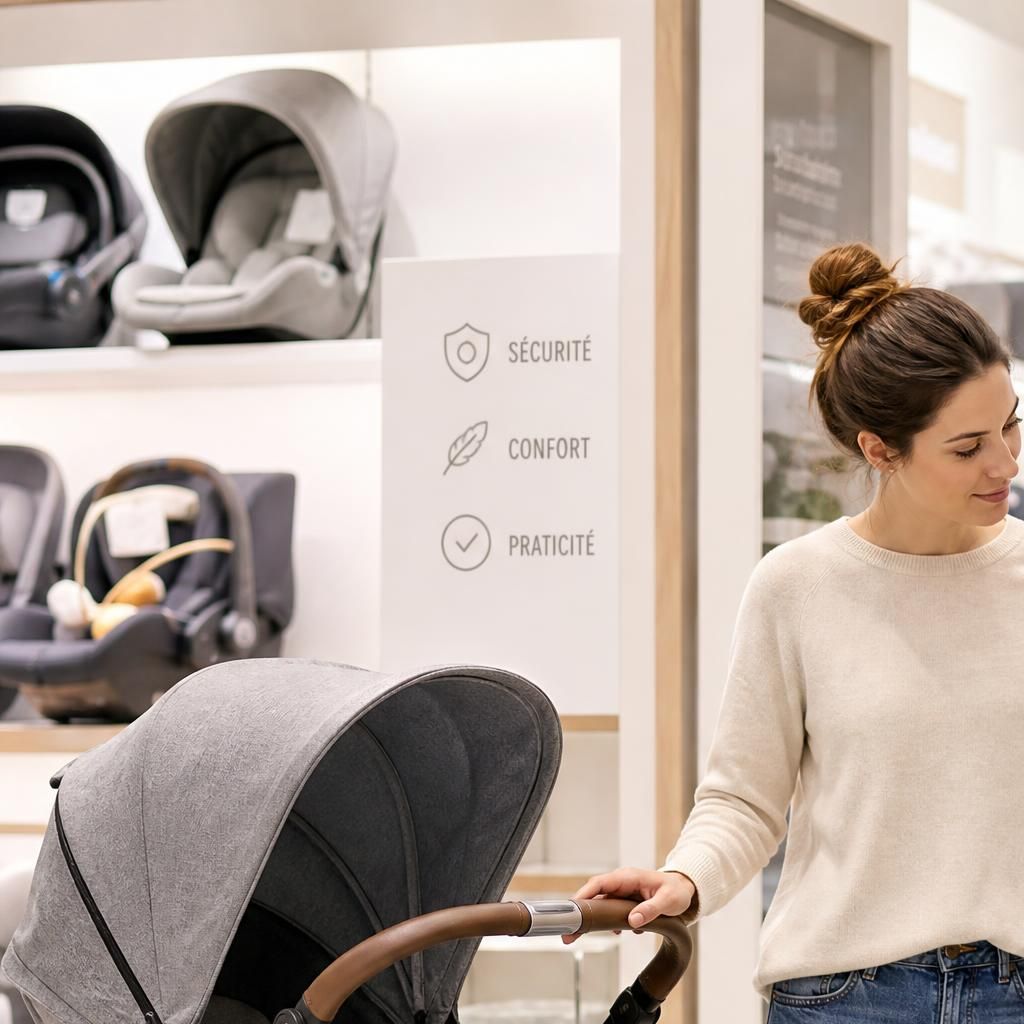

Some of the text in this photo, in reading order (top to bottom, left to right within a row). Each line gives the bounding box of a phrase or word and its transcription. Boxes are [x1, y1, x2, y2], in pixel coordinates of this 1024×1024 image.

[509, 335, 591, 363] SÉCURITÉ
[509, 437, 590, 460] CONFORT
[510, 530, 594, 556] PRATICITÉ
